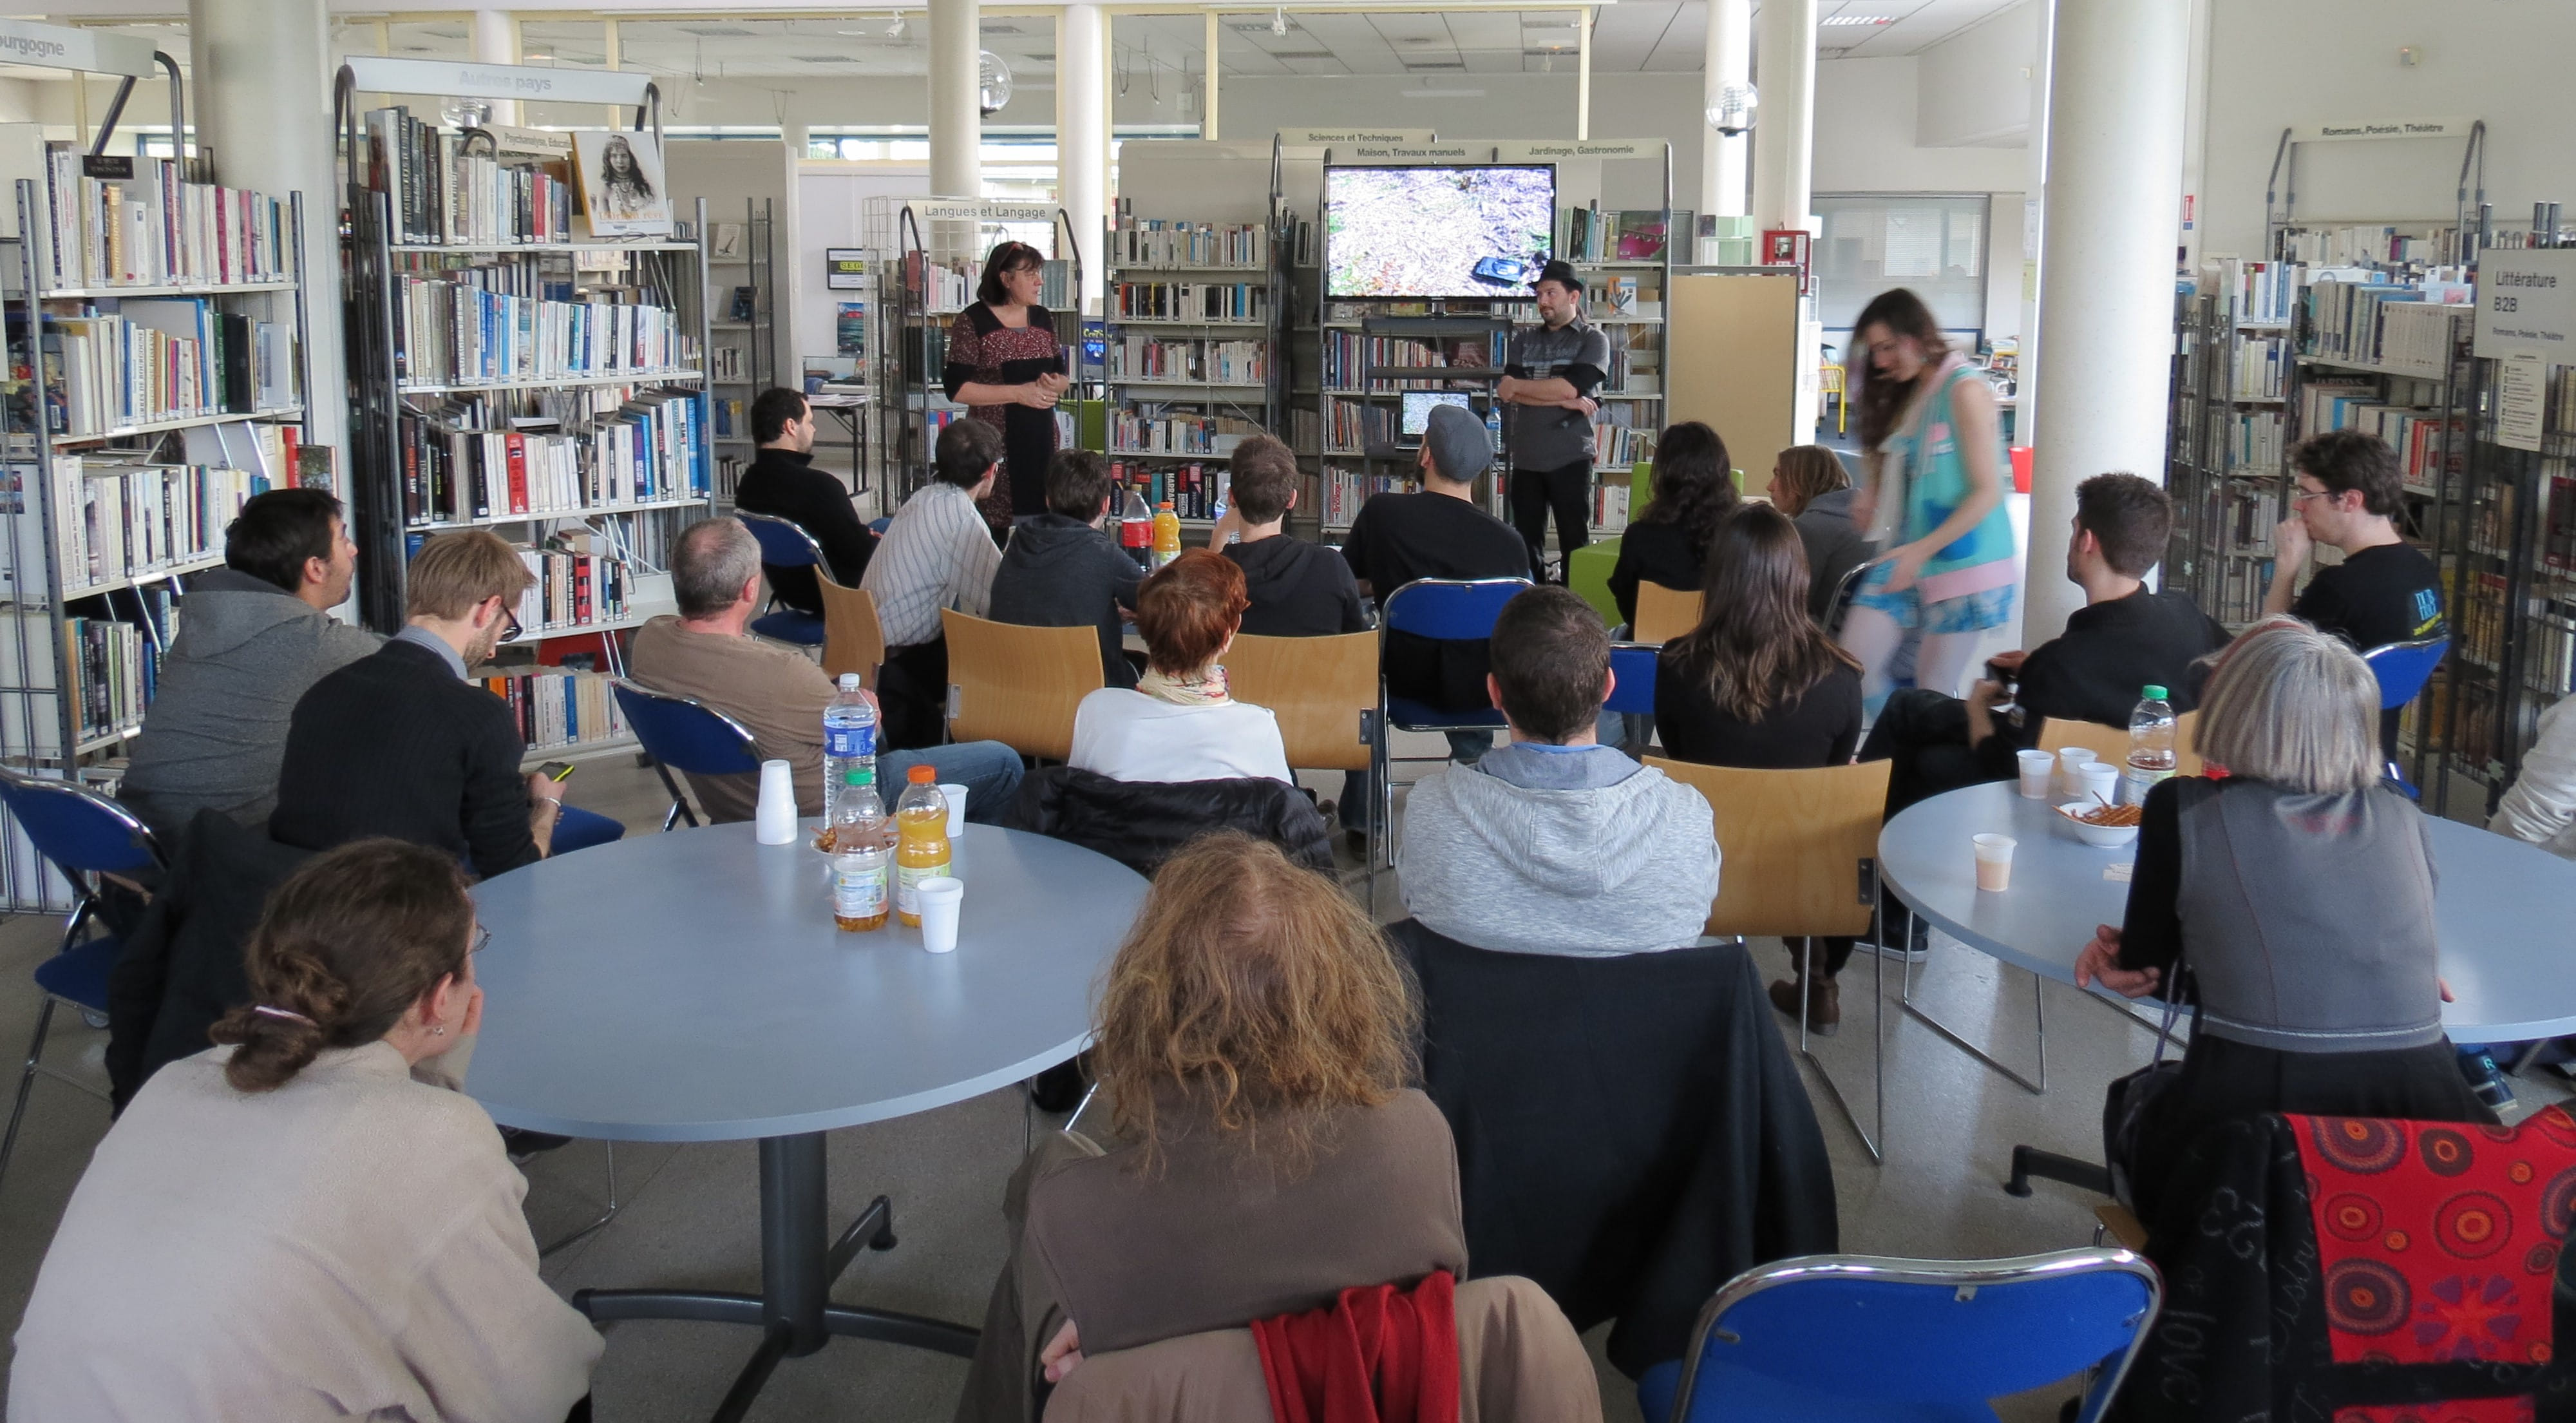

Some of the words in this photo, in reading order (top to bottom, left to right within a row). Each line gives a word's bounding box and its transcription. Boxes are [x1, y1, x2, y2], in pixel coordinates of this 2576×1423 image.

[515, 77, 552, 93] pays
[2404, 123, 2444, 133] Théâtre
[1309, 133, 1343, 142] Sciences
[1347, 134, 1355, 142] et
[1358, 133, 1403, 144] Techniques
[1357, 148, 1390, 158] Maison,
[1392, 148, 1426, 157] Travaux
[1429, 148, 1466, 157] manuels
[1529, 146, 1575, 156] Jardinage,
[1577, 146, 1634, 155] Gastronomie
[925, 205, 977, 218] Langues
[980, 207, 992, 217] et
[996, 206, 1046, 219] Langage
[2496, 271, 2557, 289] Littérature
[2494, 296, 2517, 312] B2B
[409, 478, 417, 493] ARTS
[1167, 473, 1175, 506] HARRAP
[1333, 484, 1341, 512] Bricolage
